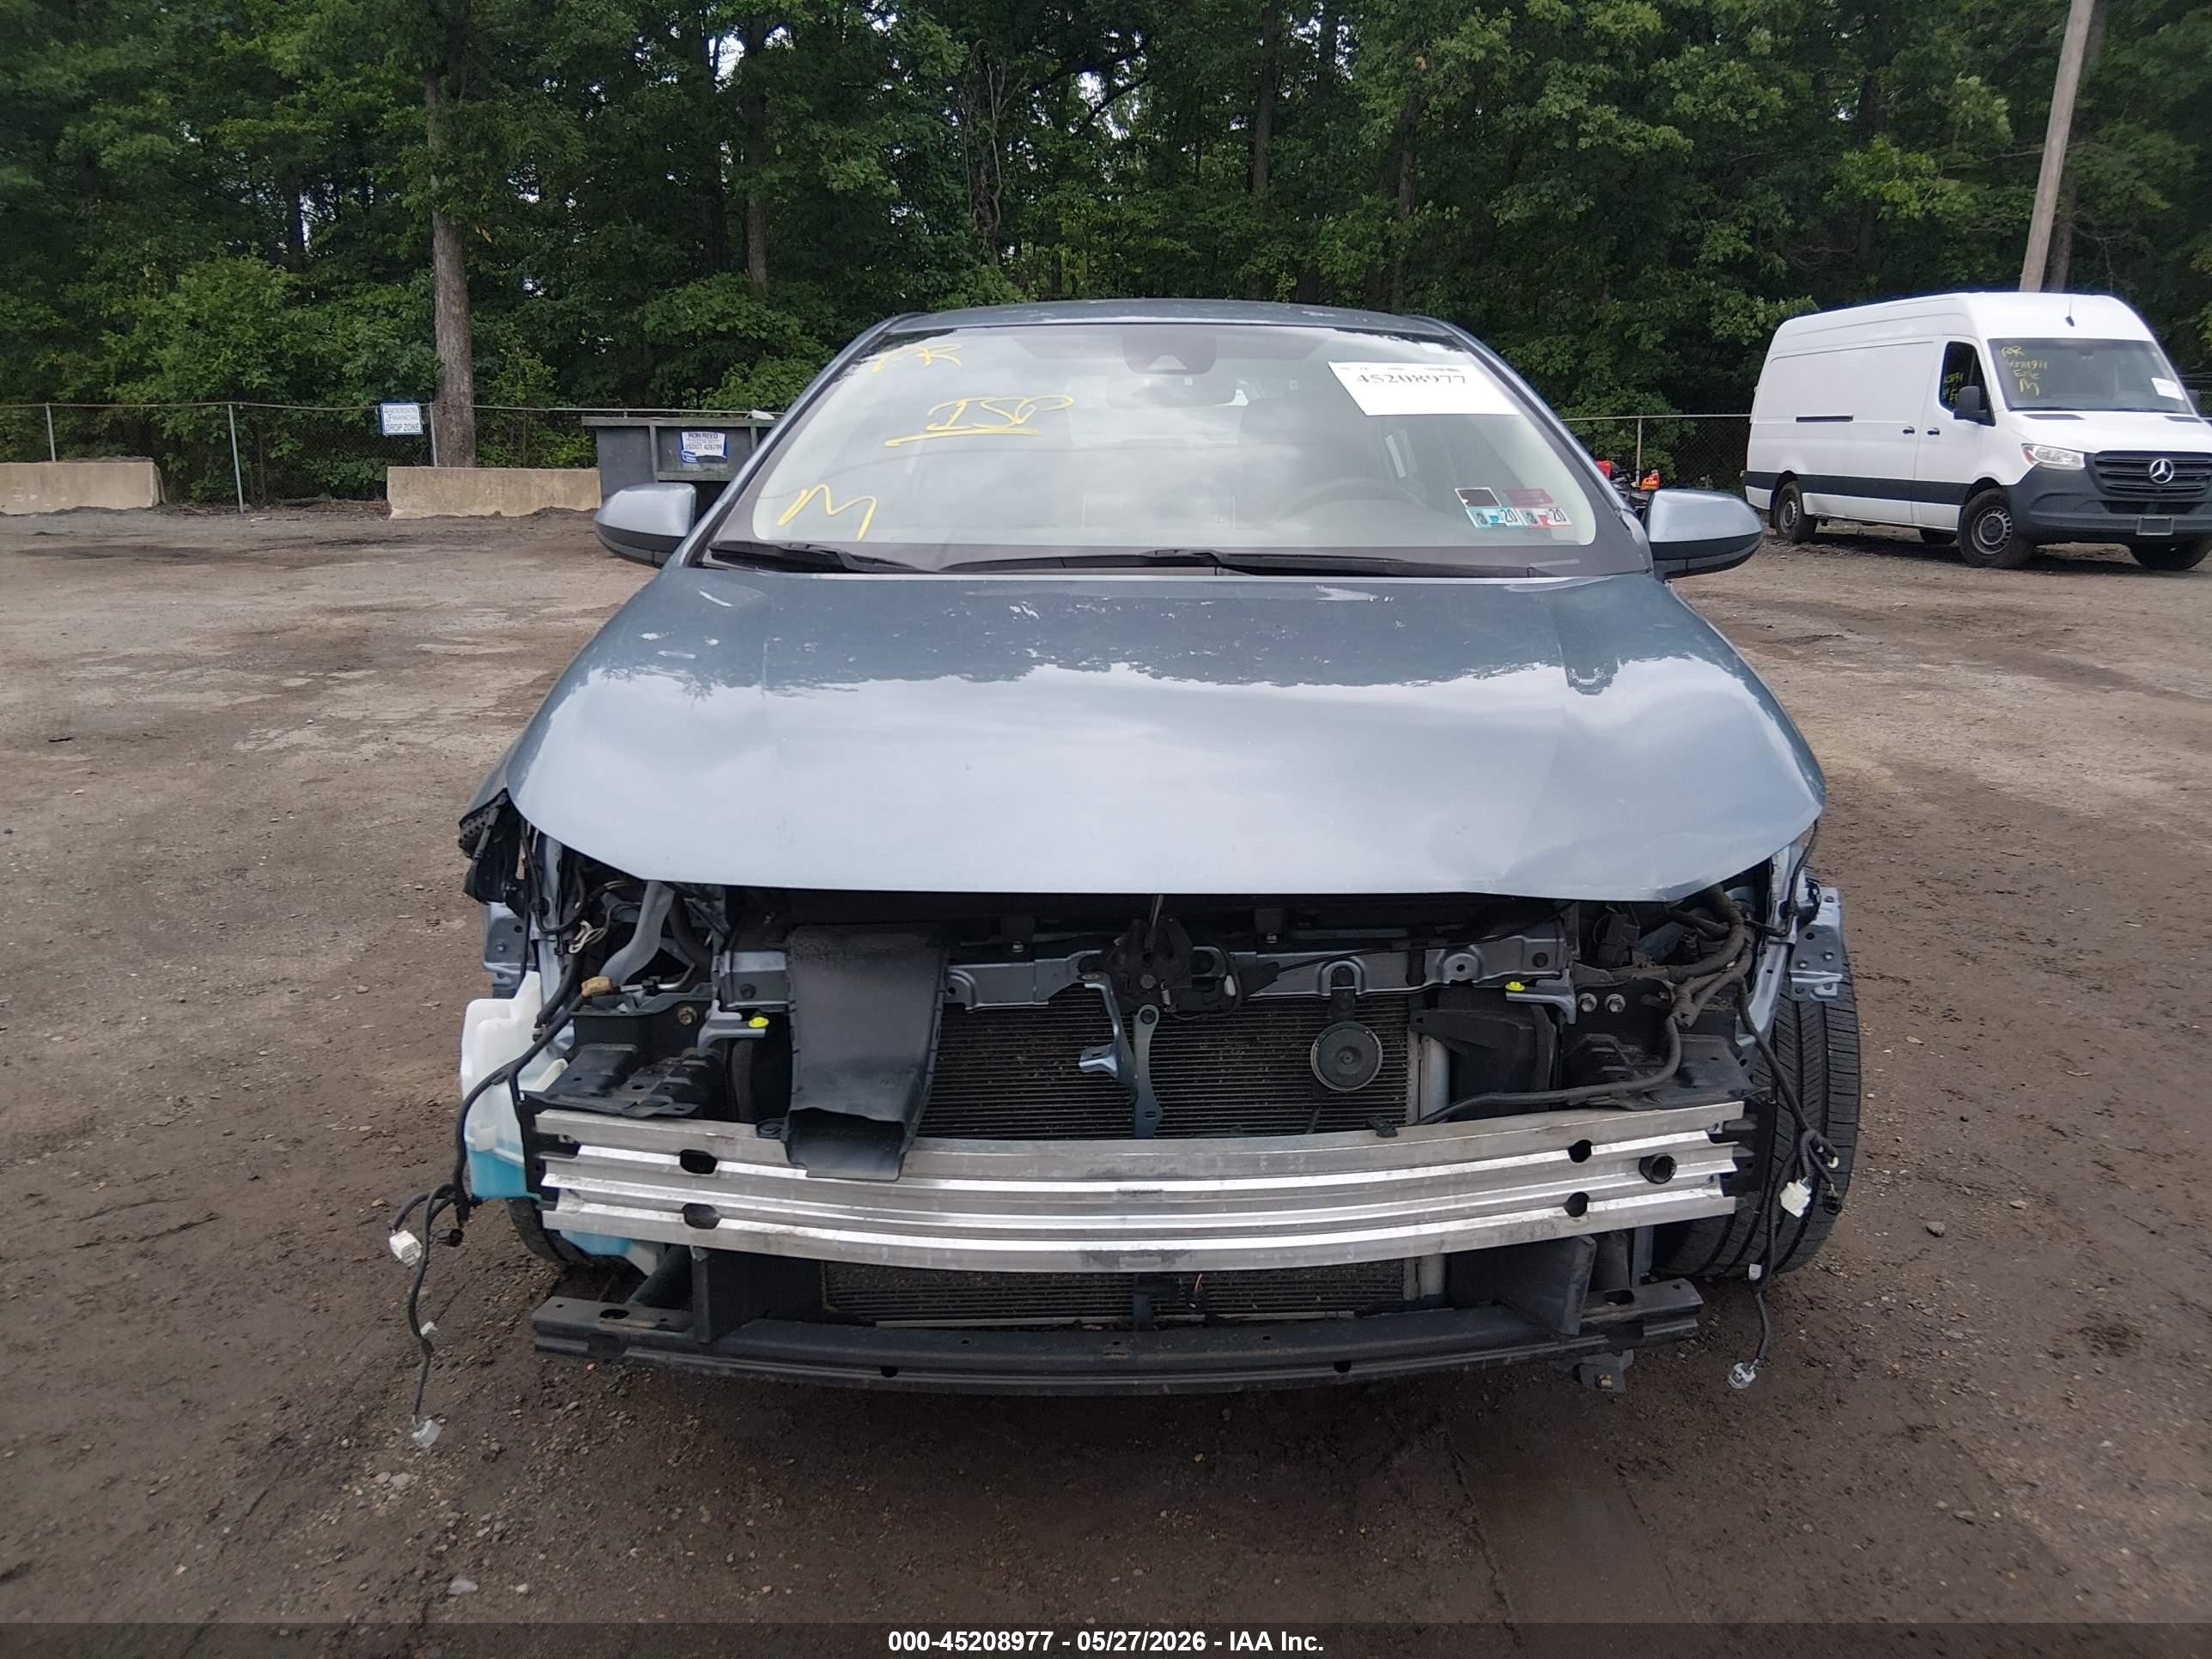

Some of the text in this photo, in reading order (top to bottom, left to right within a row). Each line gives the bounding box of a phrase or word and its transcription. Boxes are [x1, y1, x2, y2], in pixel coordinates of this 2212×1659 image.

[386, 422, 420, 432] DROP ZONE
[1499, 509, 1517, 523] 20
[1548, 508, 1567, 522] 20
